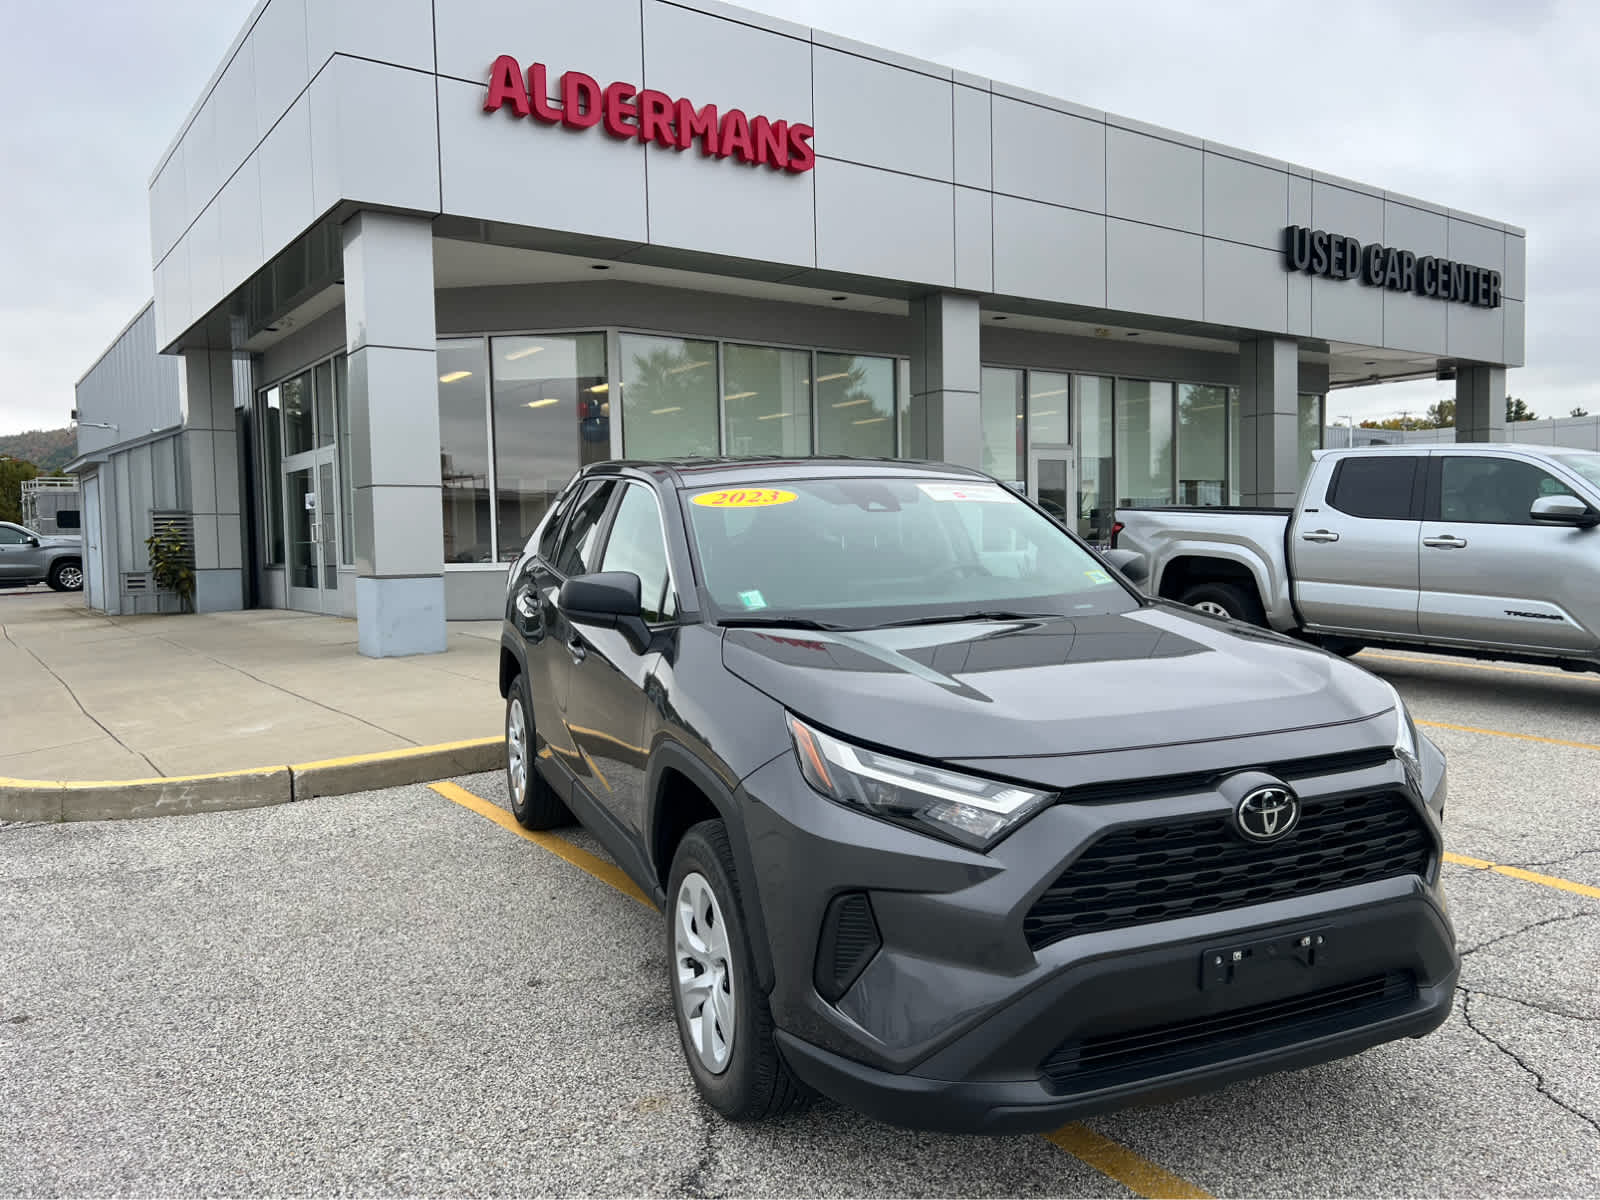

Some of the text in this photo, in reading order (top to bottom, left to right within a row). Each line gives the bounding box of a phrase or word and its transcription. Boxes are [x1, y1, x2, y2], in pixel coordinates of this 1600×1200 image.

[483, 54, 815, 172] ALDERMANS
[1286, 225, 1502, 308] USED CAR CENTER
[712, 491, 779, 504] 2023
